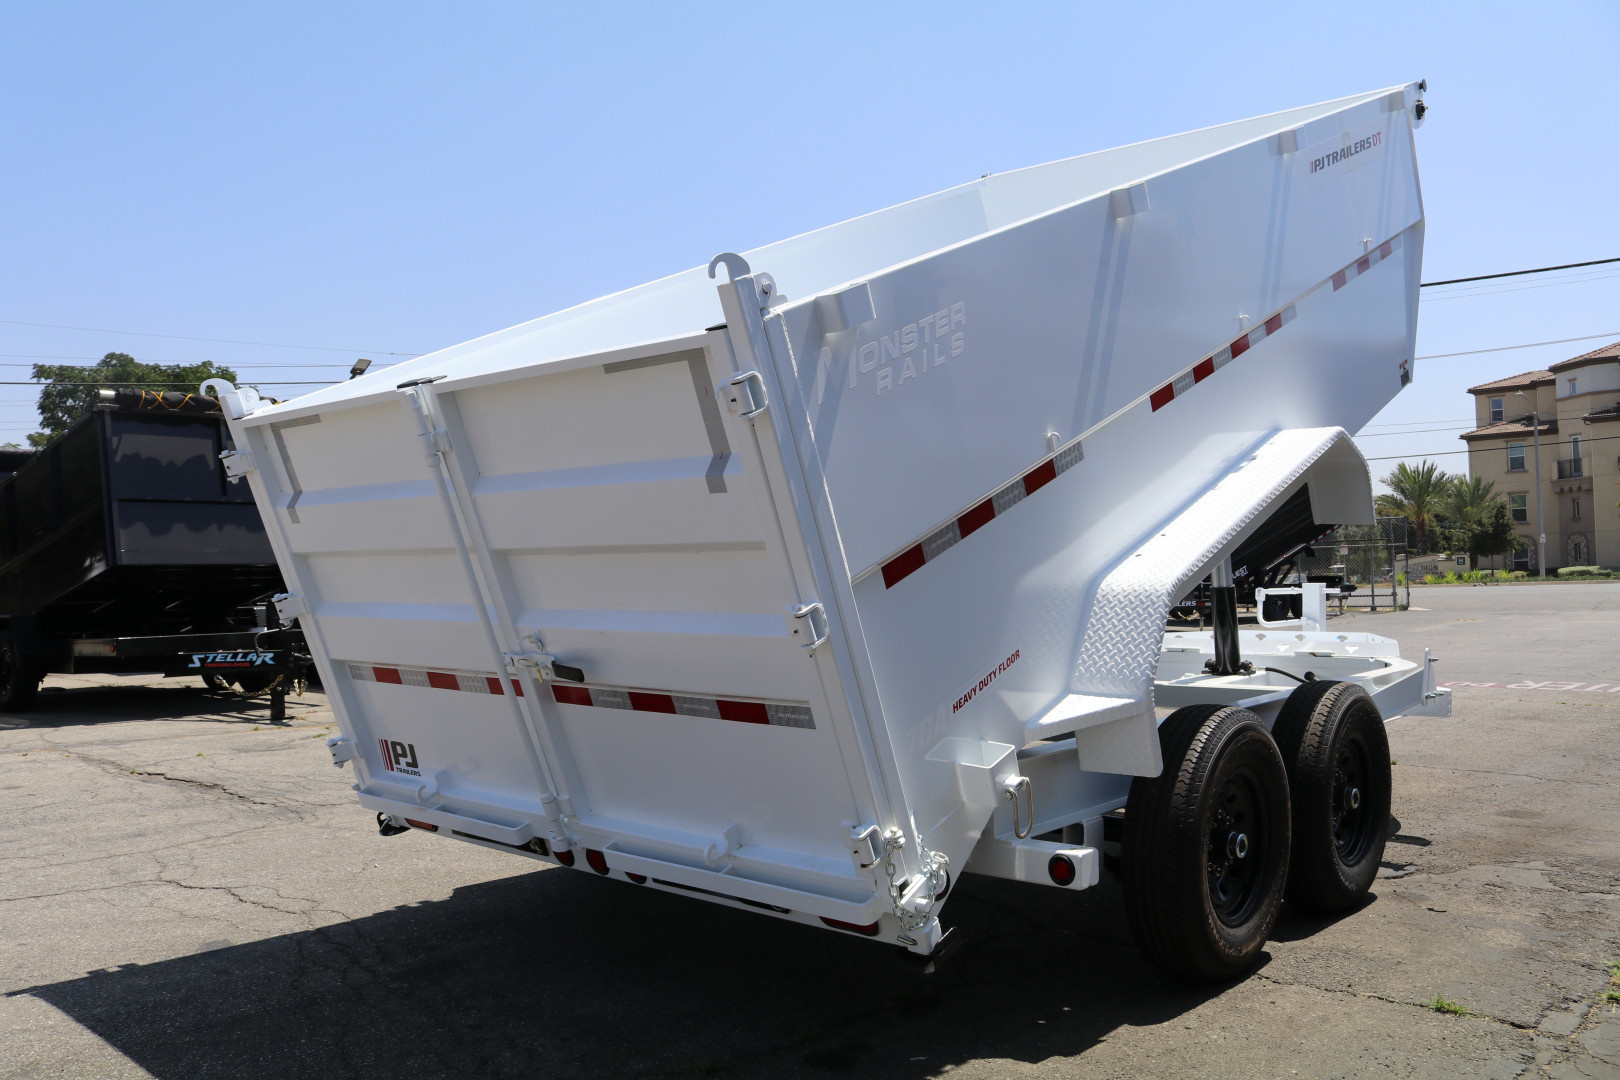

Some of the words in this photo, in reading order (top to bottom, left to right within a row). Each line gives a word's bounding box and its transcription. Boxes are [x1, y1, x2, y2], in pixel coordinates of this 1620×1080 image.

[817, 302, 966, 405] MONSTER
[875, 331, 965, 396] RAILS
[188, 652, 276, 668] STELLAR
[952, 685, 977, 714] HEAVY
[978, 668, 998, 692] DUTY
[998, 649, 1020, 675] FLOOR
[390, 741, 419, 768] PJ
[396, 767, 421, 777] TRAILERS
